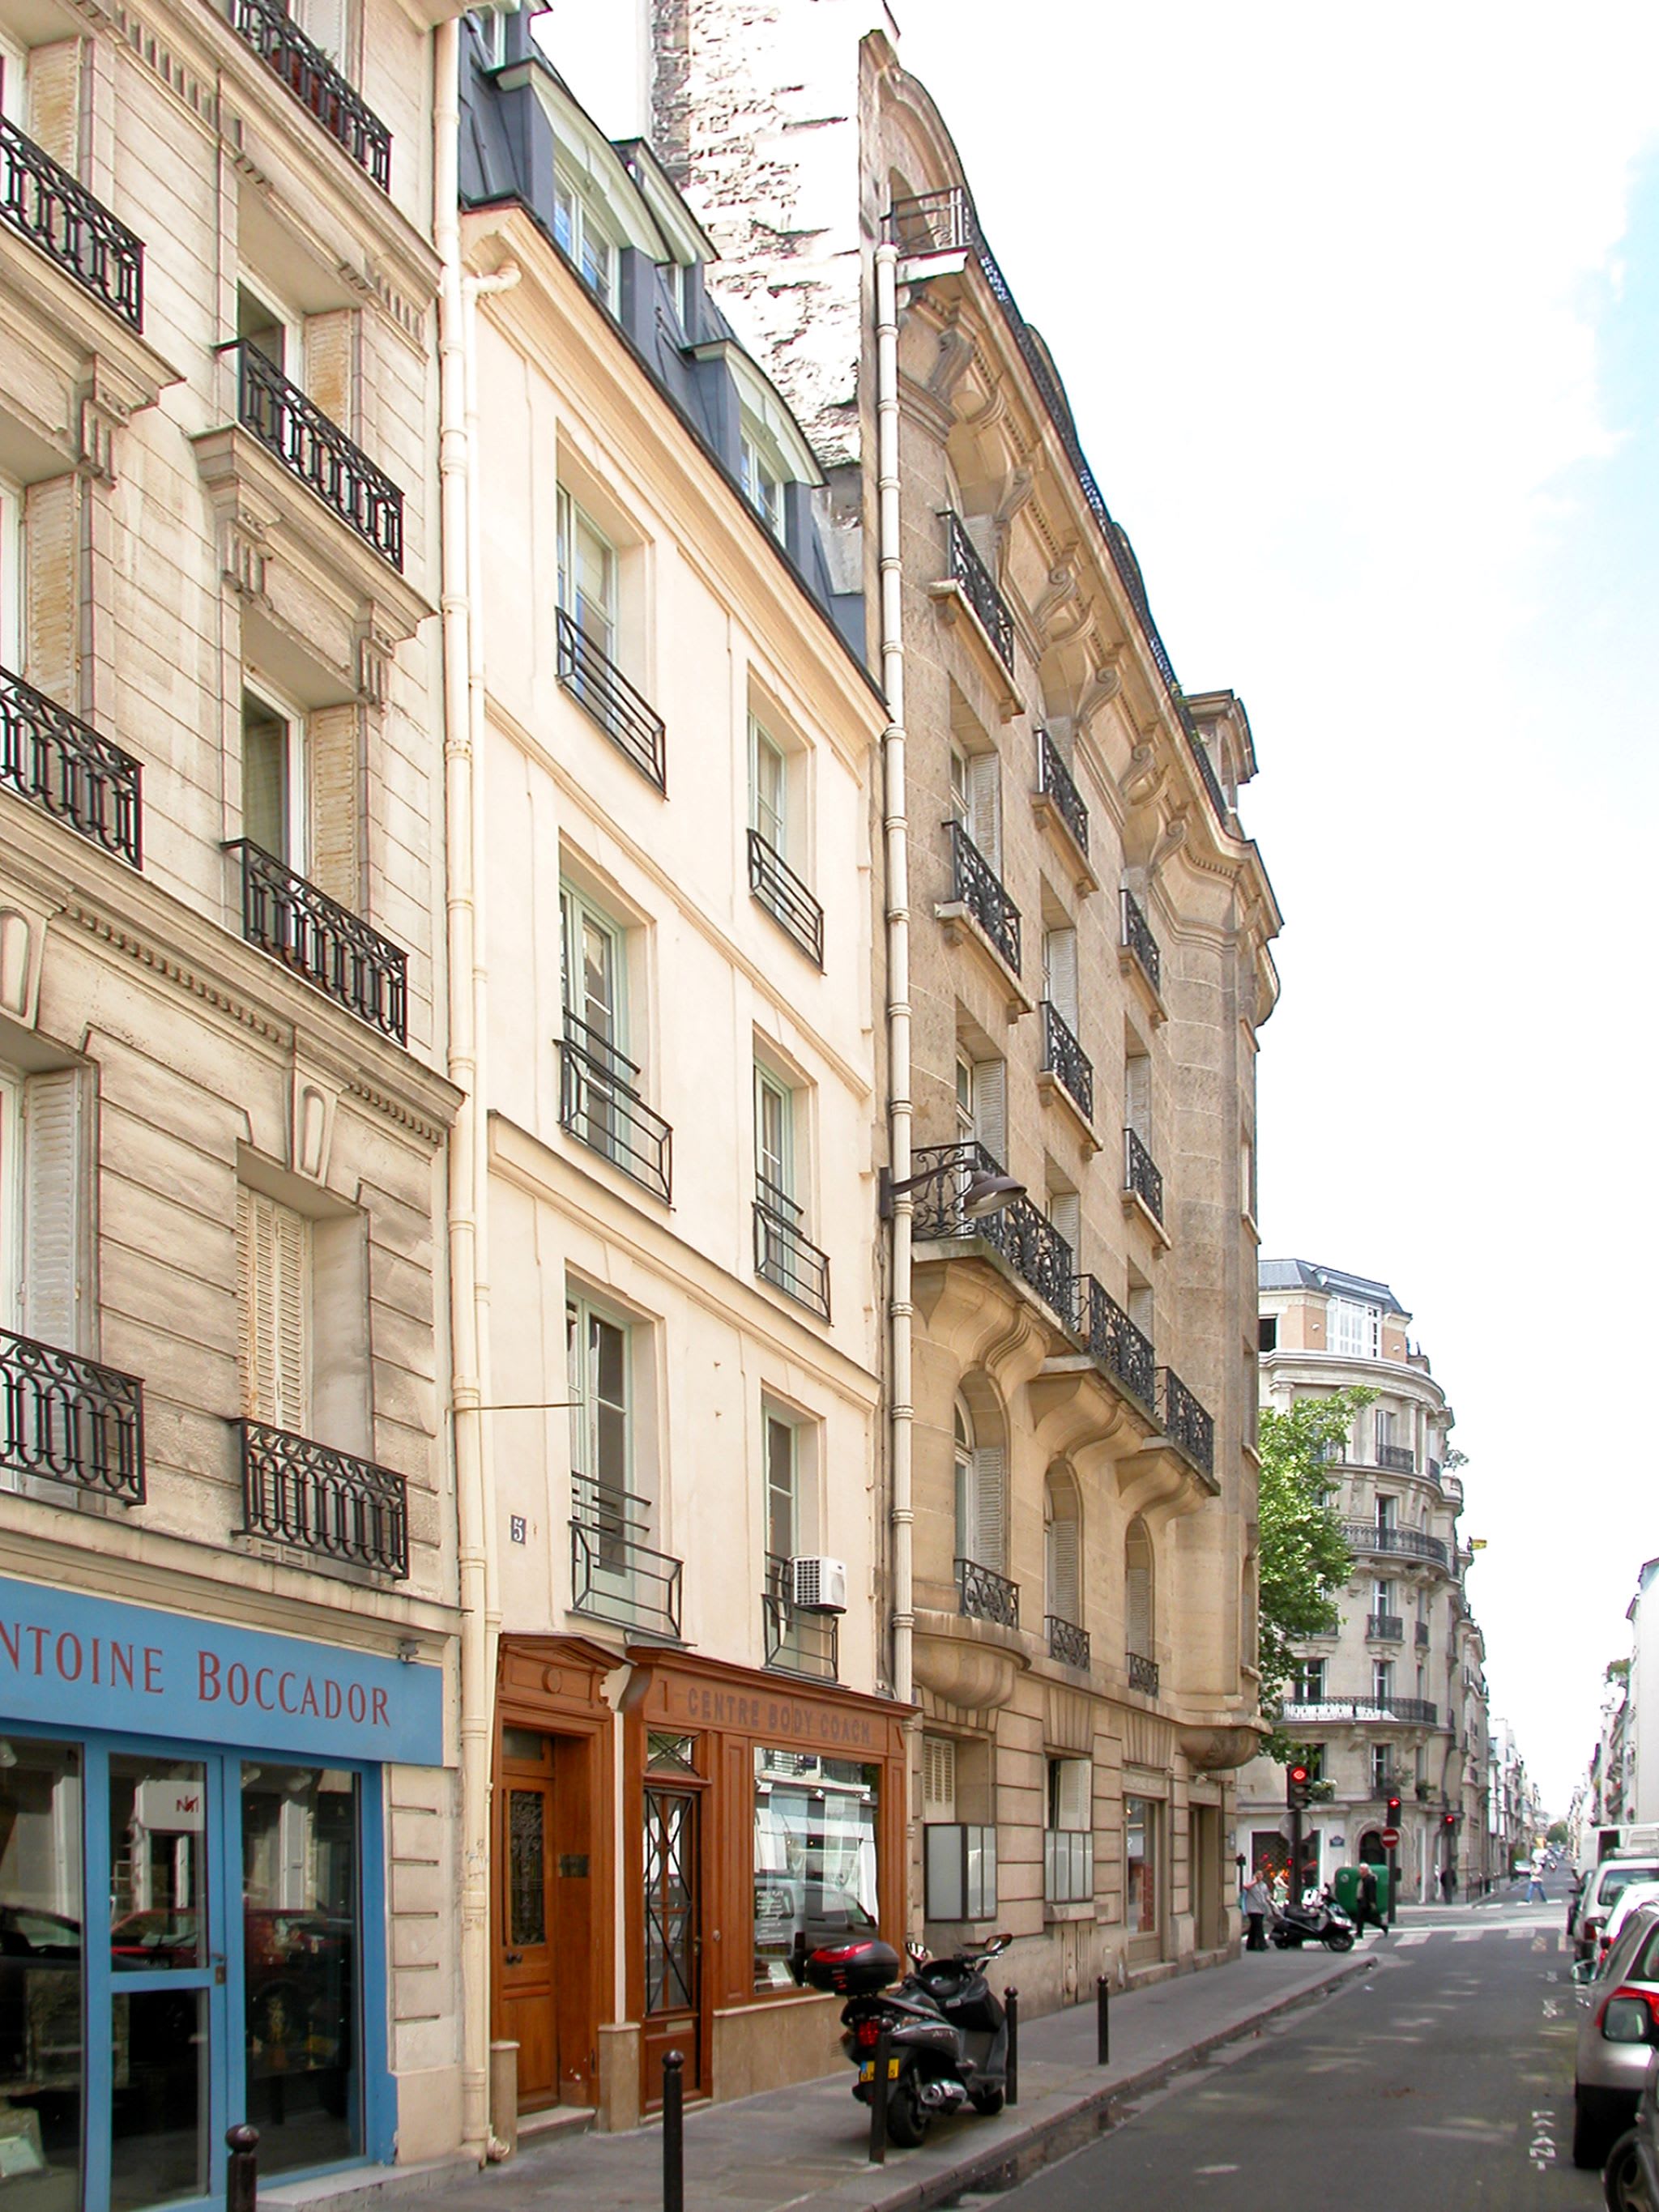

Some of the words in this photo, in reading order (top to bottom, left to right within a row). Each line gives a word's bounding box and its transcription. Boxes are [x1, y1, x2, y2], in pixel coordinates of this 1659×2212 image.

[513, 1517, 523, 1542] 5
[198, 1650, 390, 1727] BOCCADOR
[688, 1687, 760, 1728] CENTRE
[768, 1703, 812, 1736] BODY
[820, 1711, 871, 1745] COACH
